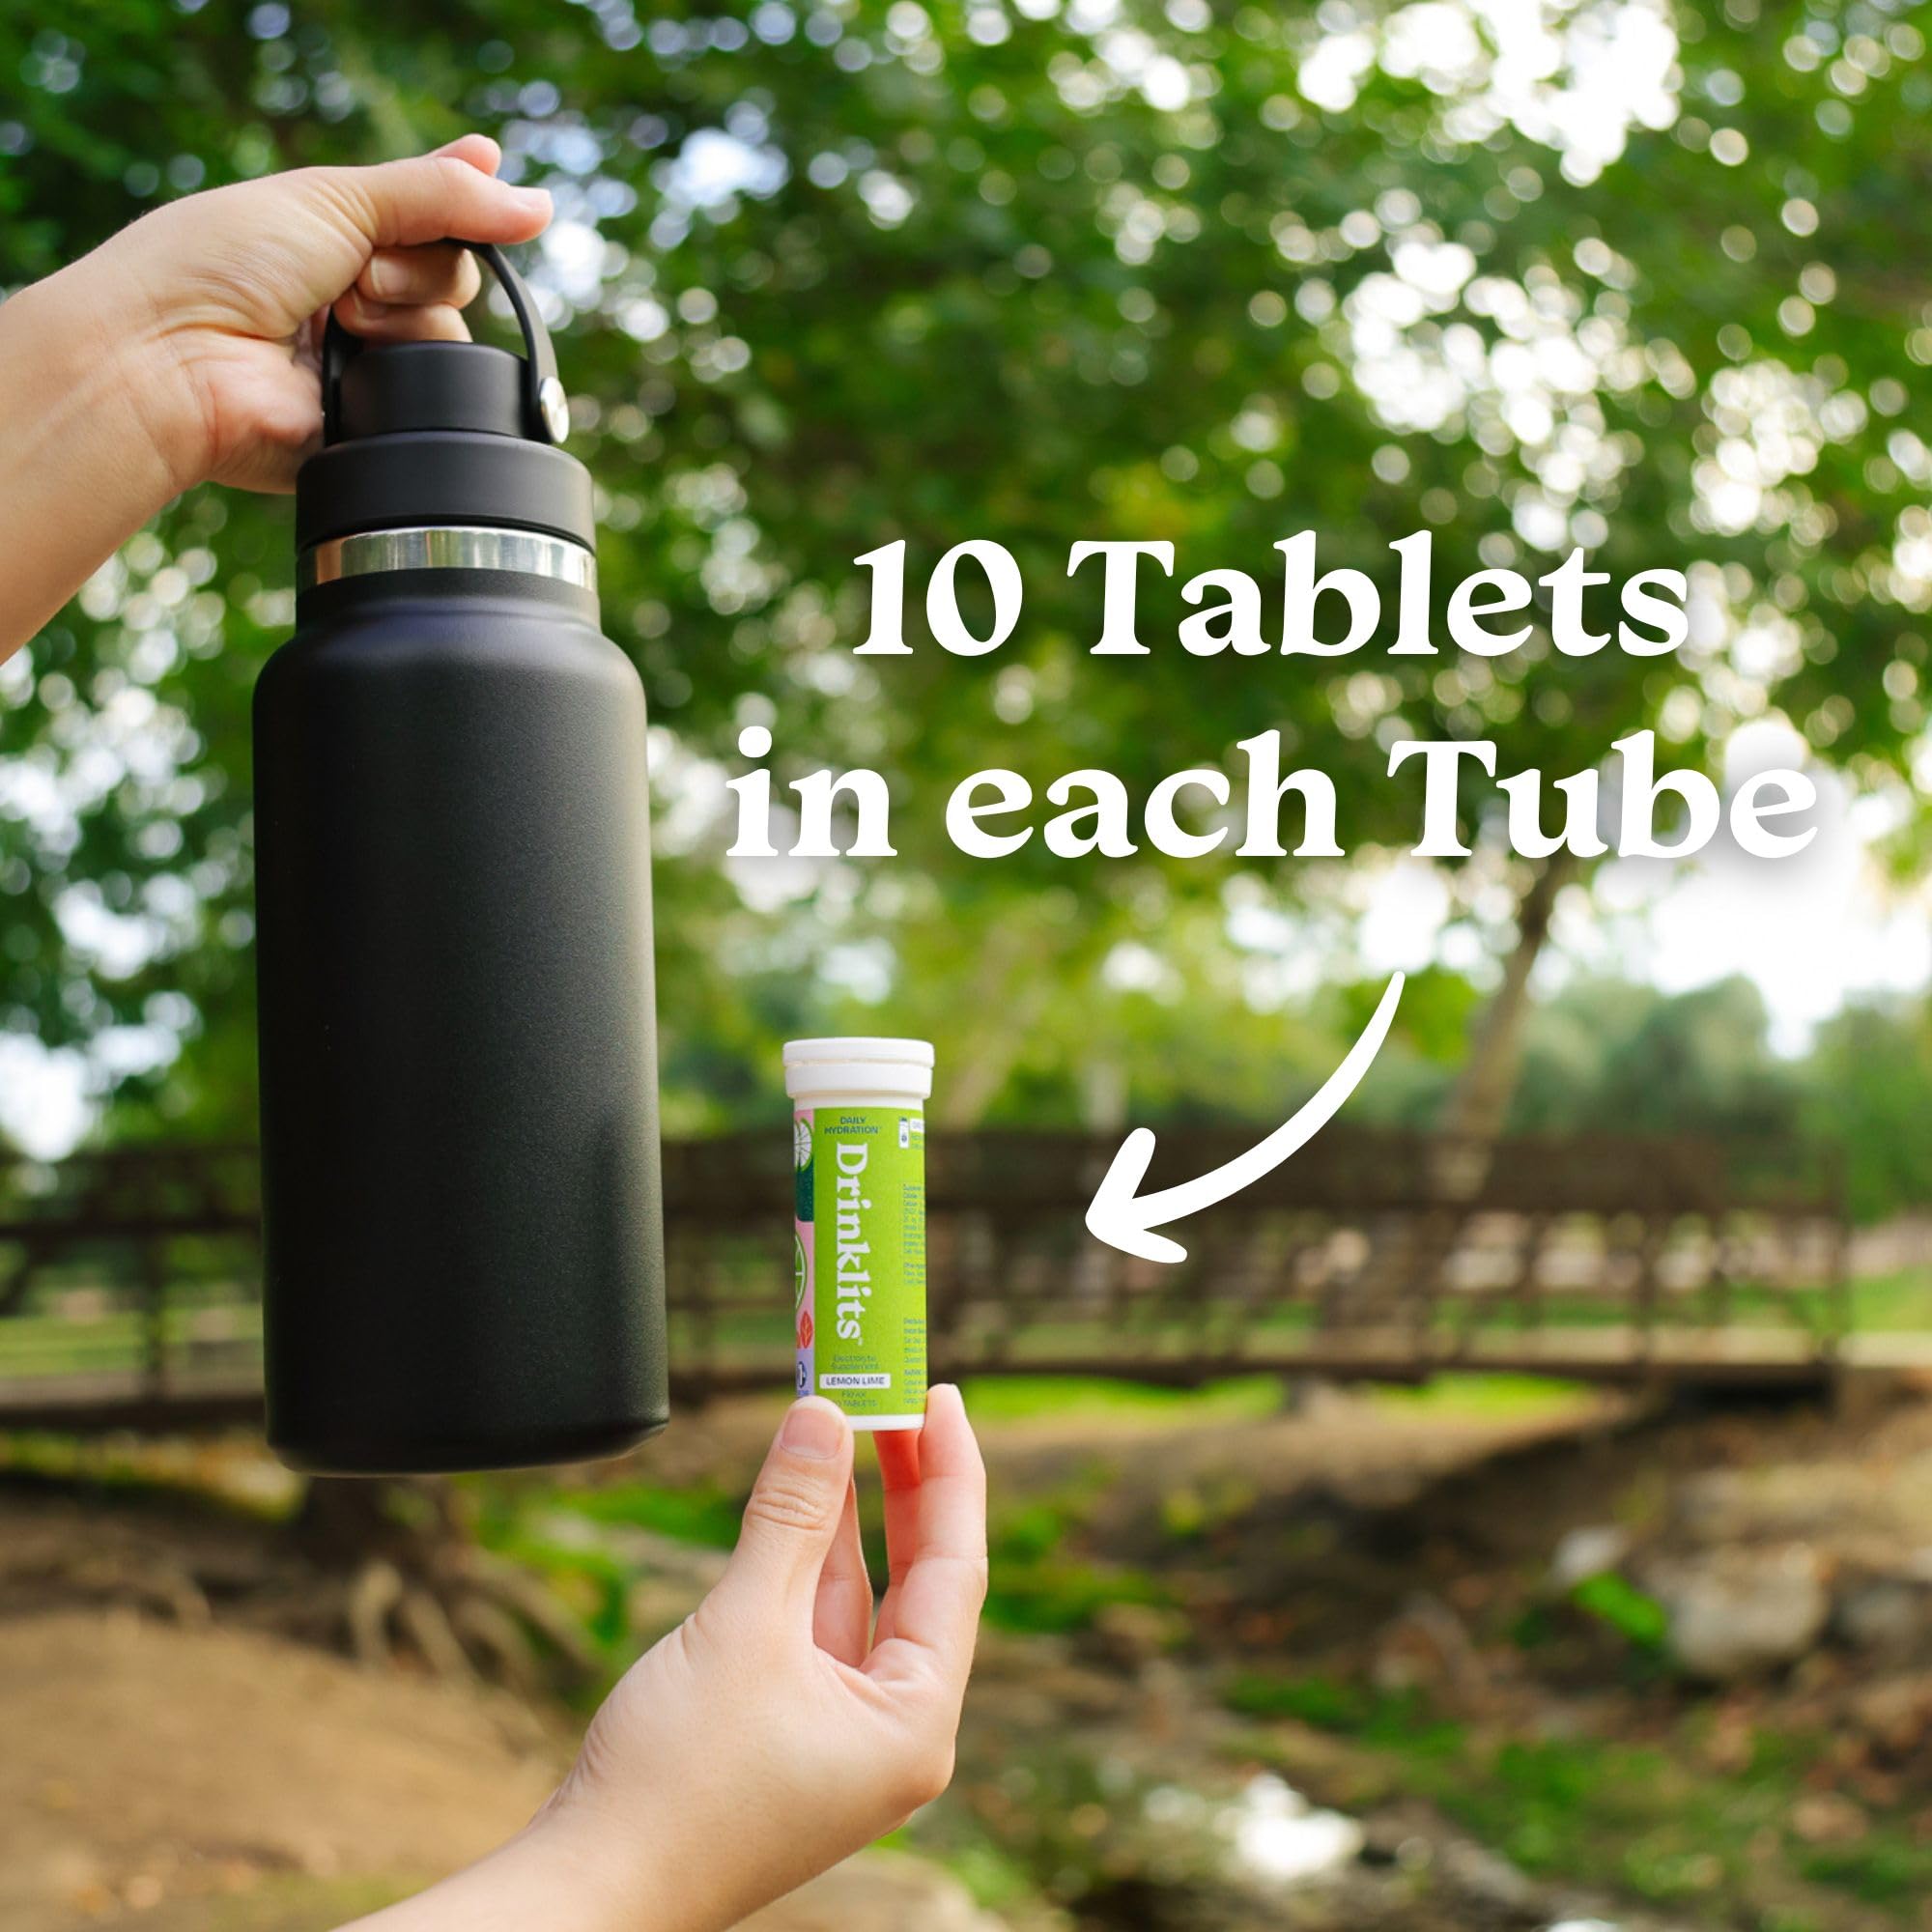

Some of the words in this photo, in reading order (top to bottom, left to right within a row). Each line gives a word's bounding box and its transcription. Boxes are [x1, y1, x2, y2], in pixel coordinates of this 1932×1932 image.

[839, 1116, 867, 1124] DAILY
[824, 1124, 879, 1135] HYDRATION
[837, 1142, 872, 1340] Drinklits
[826, 1377, 861, 1385] LEMON
[862, 1377, 885, 1385] LIME
